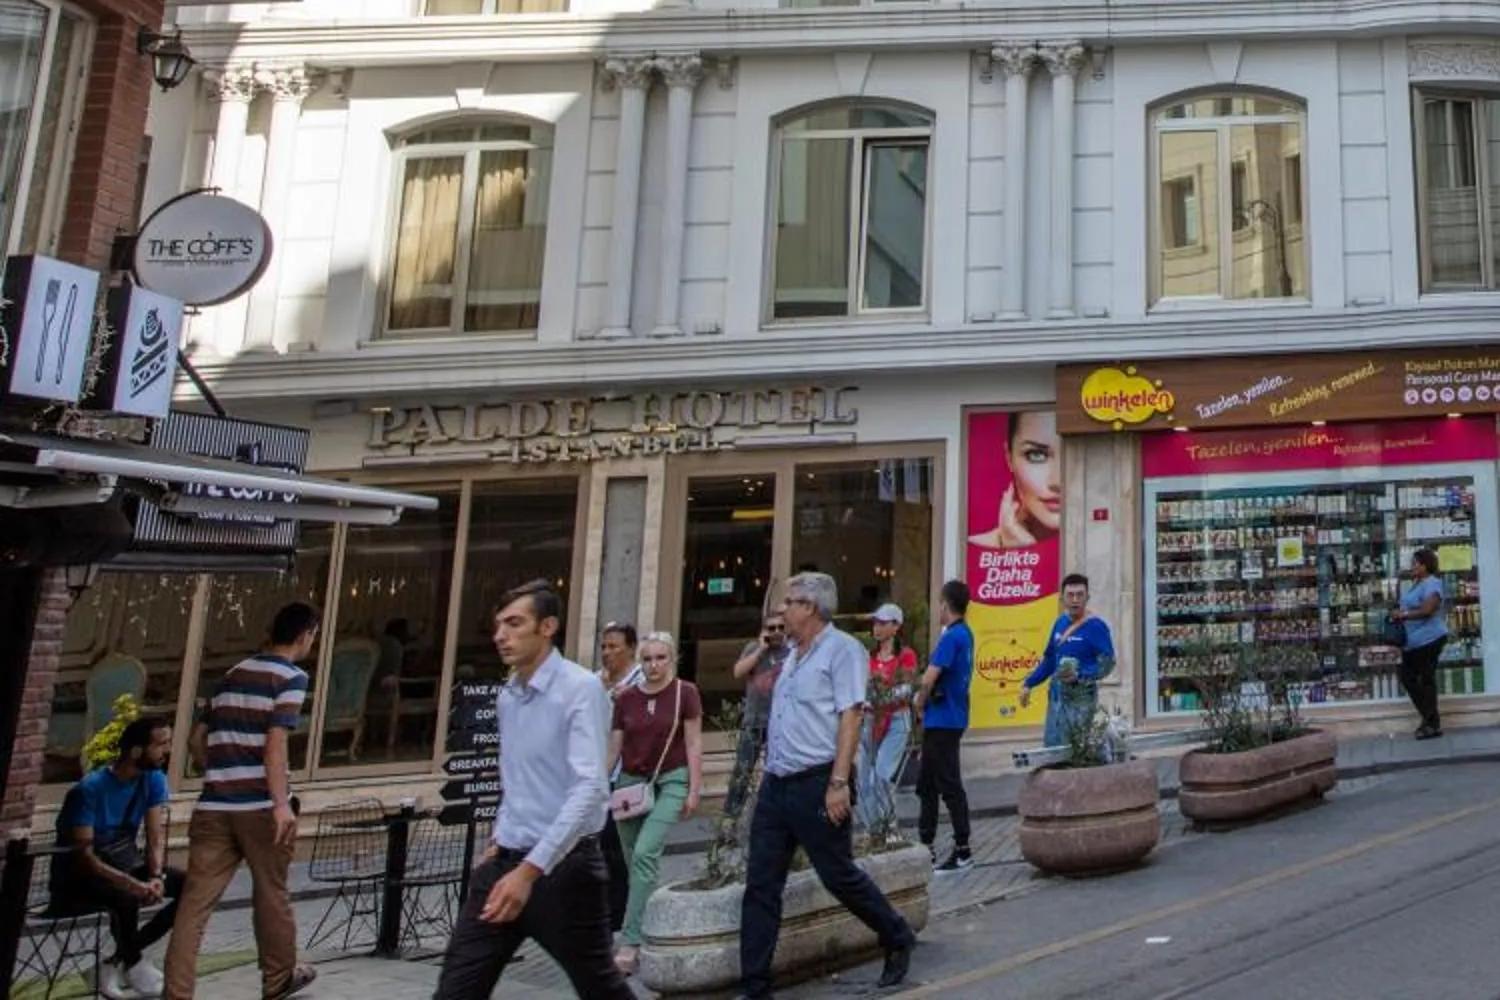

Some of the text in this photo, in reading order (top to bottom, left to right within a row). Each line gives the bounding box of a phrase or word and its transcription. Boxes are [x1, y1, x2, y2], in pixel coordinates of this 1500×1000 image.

[147, 239, 184, 257] THE
[1085, 389, 1172, 412] winkelen
[366, 387, 859, 448] PALDE HOTEL
[979, 551, 1040, 569] Birlikte
[986, 567, 1033, 584] Daha
[977, 582, 1042, 600] Güzeliz
[462, 685, 489, 697] TAKE
[475, 709, 498, 721] COF
[472, 733, 502, 745] FROZ
[449, 757, 498, 771] BREAKFA
[463, 780, 501, 795] BURGE
[473, 805, 498, 819] PIZZ
